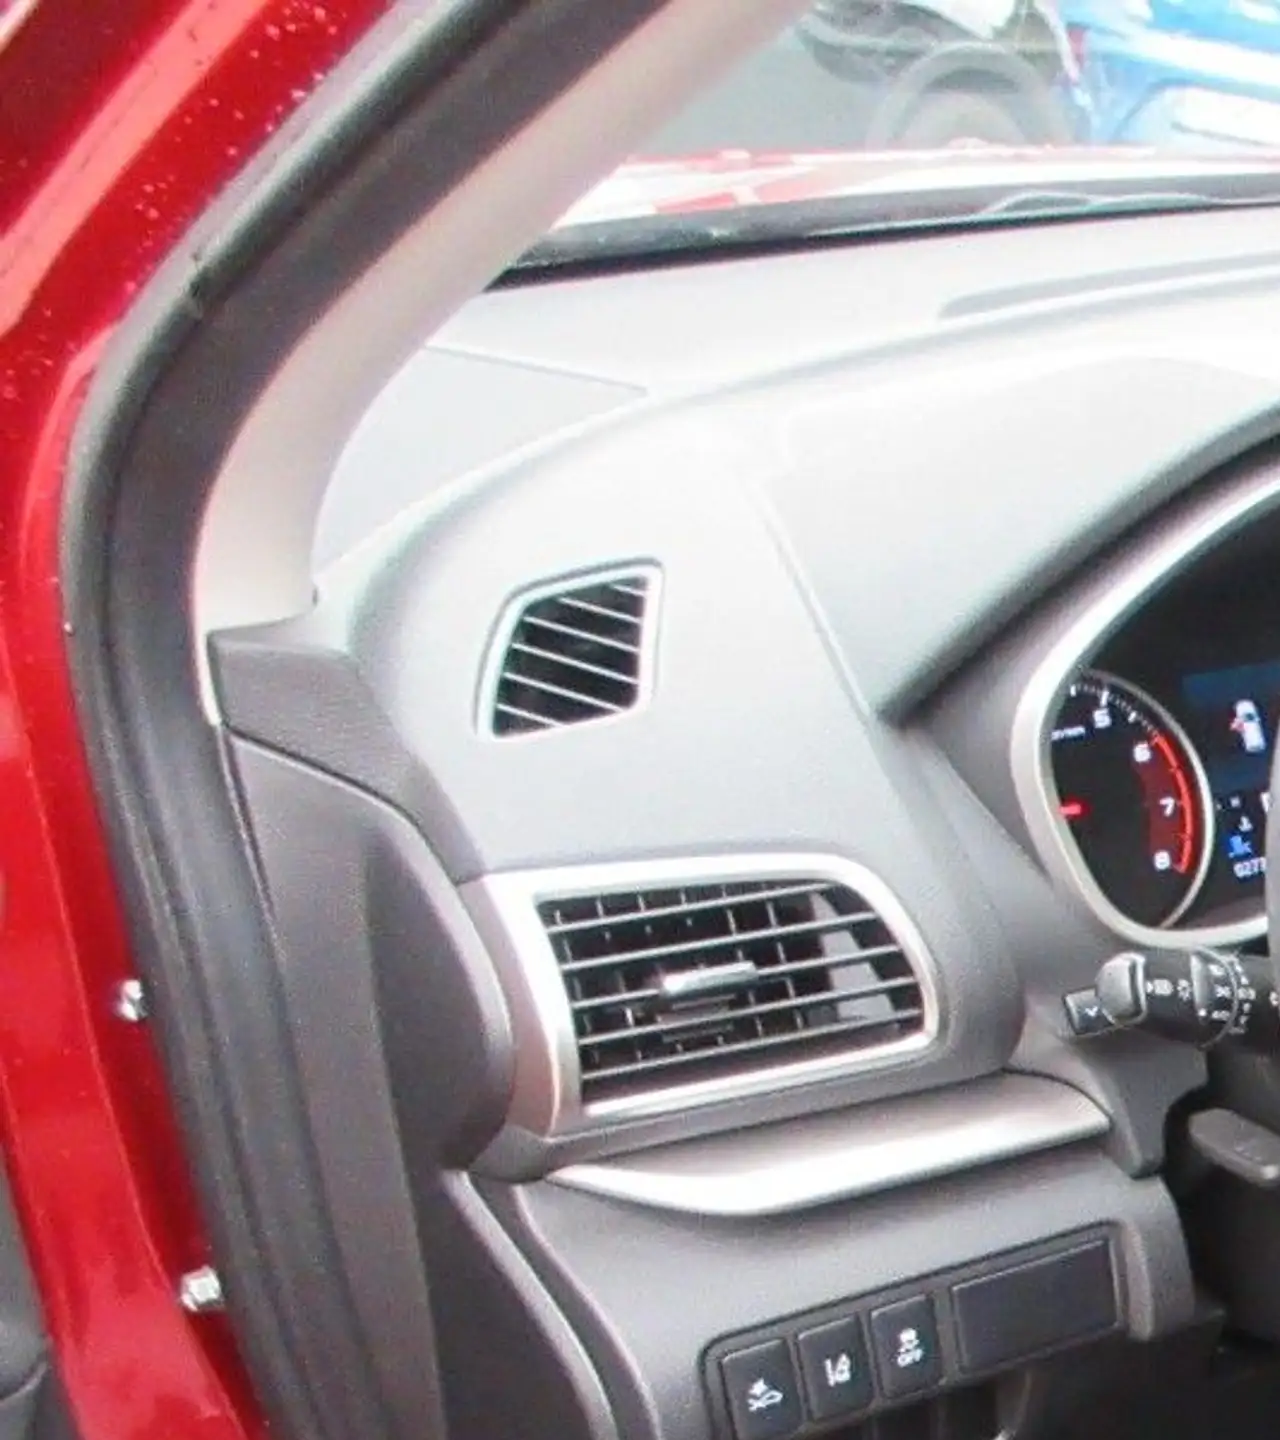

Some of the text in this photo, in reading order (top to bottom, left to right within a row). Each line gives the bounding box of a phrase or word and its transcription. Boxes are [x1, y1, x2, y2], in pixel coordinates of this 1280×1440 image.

[1093, 708, 1112, 729] 5
[1133, 742, 1151, 763] 6
[1160, 796, 1175, 817] 7
[1154, 850, 1171, 872] 8
